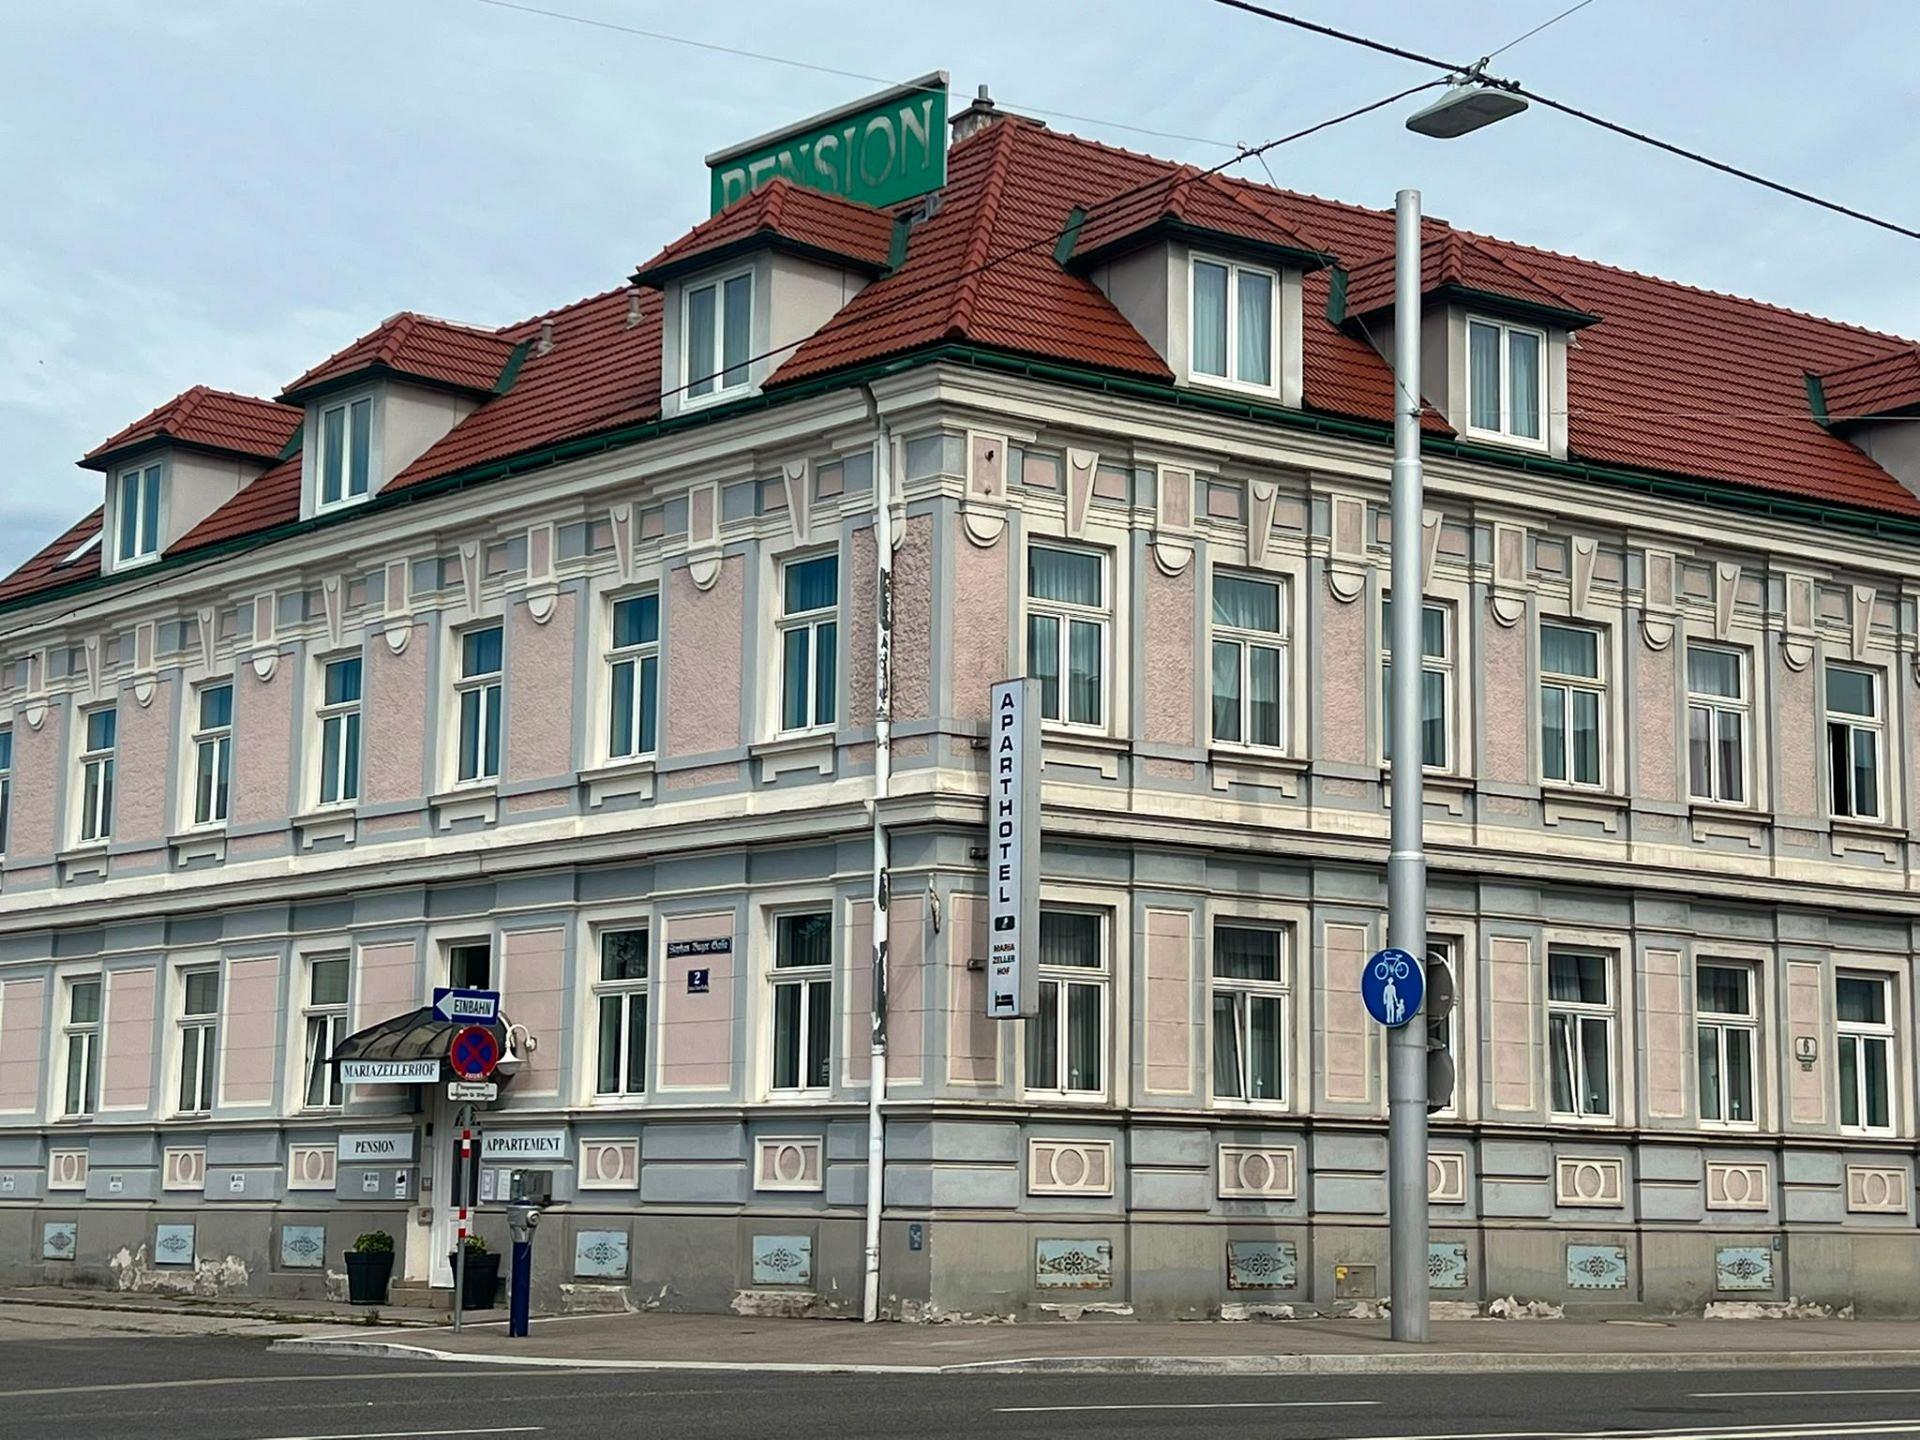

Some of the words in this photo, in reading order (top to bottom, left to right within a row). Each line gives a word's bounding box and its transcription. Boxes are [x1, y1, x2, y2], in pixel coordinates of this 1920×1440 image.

[999, 692, 1014, 903] APARTHOTEL
[694, 972, 701, 984] 2
[454, 999, 492, 1015] EINBAHN
[1803, 1039, 1809, 1053] 6
[344, 1063, 436, 1077] MARIAZELLERHOF
[355, 1140, 396, 1153] PENSION
[486, 1136, 561, 1151] APPARTEMENT
